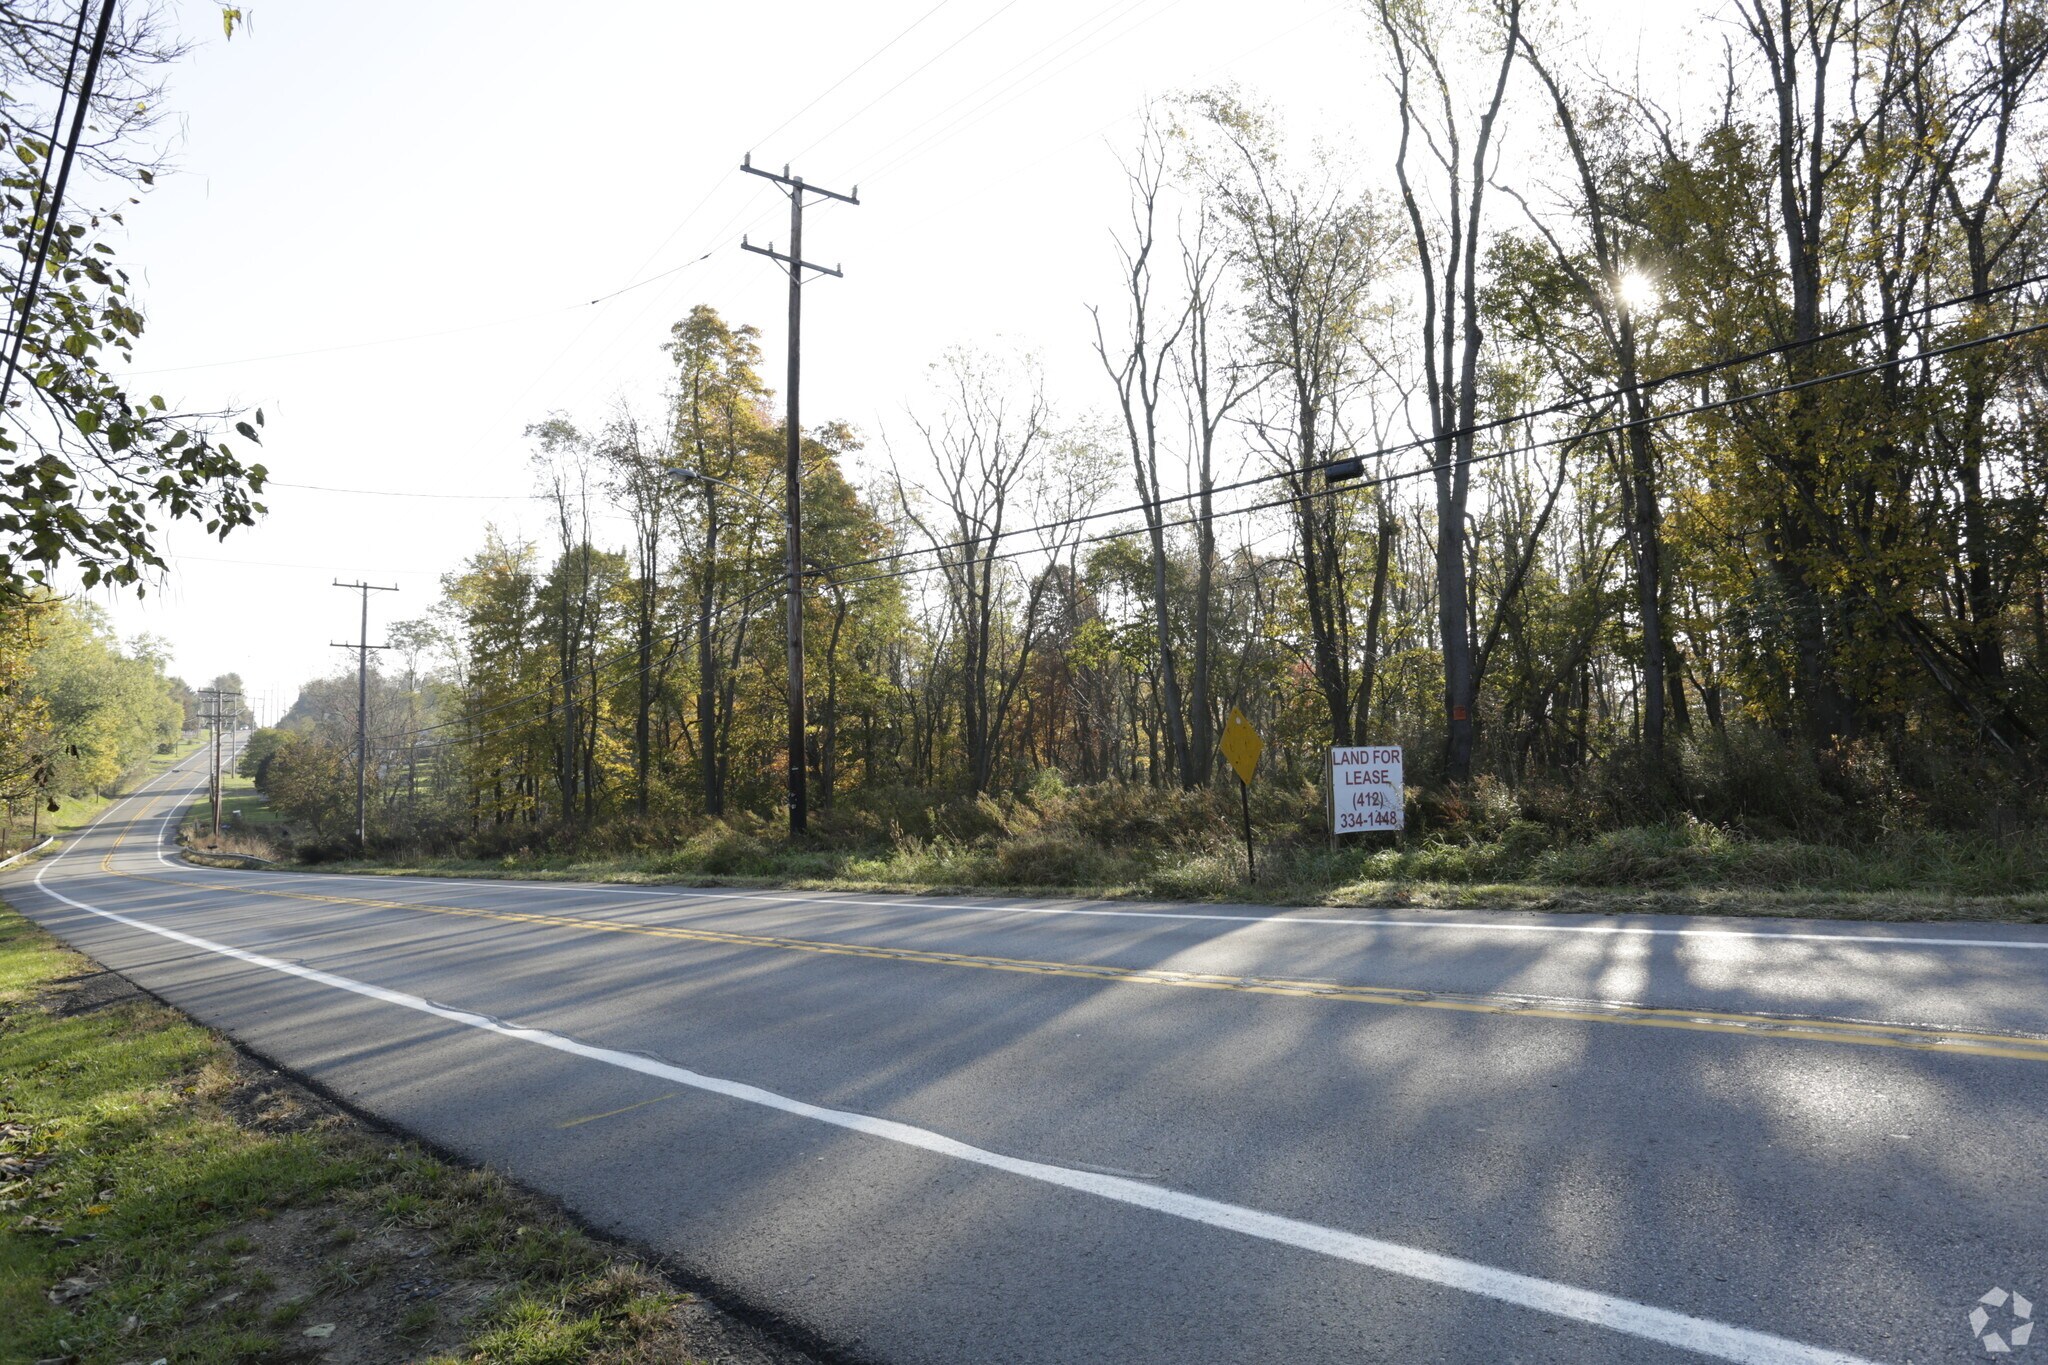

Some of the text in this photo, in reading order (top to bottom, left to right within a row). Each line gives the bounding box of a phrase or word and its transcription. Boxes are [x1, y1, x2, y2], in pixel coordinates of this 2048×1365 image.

[1333, 750, 1400, 765] LAND FOR
[1345, 770, 1391, 785] LEASE
[1353, 791, 1384, 811] (412)
[1340, 811, 1397, 828] 334-1448
